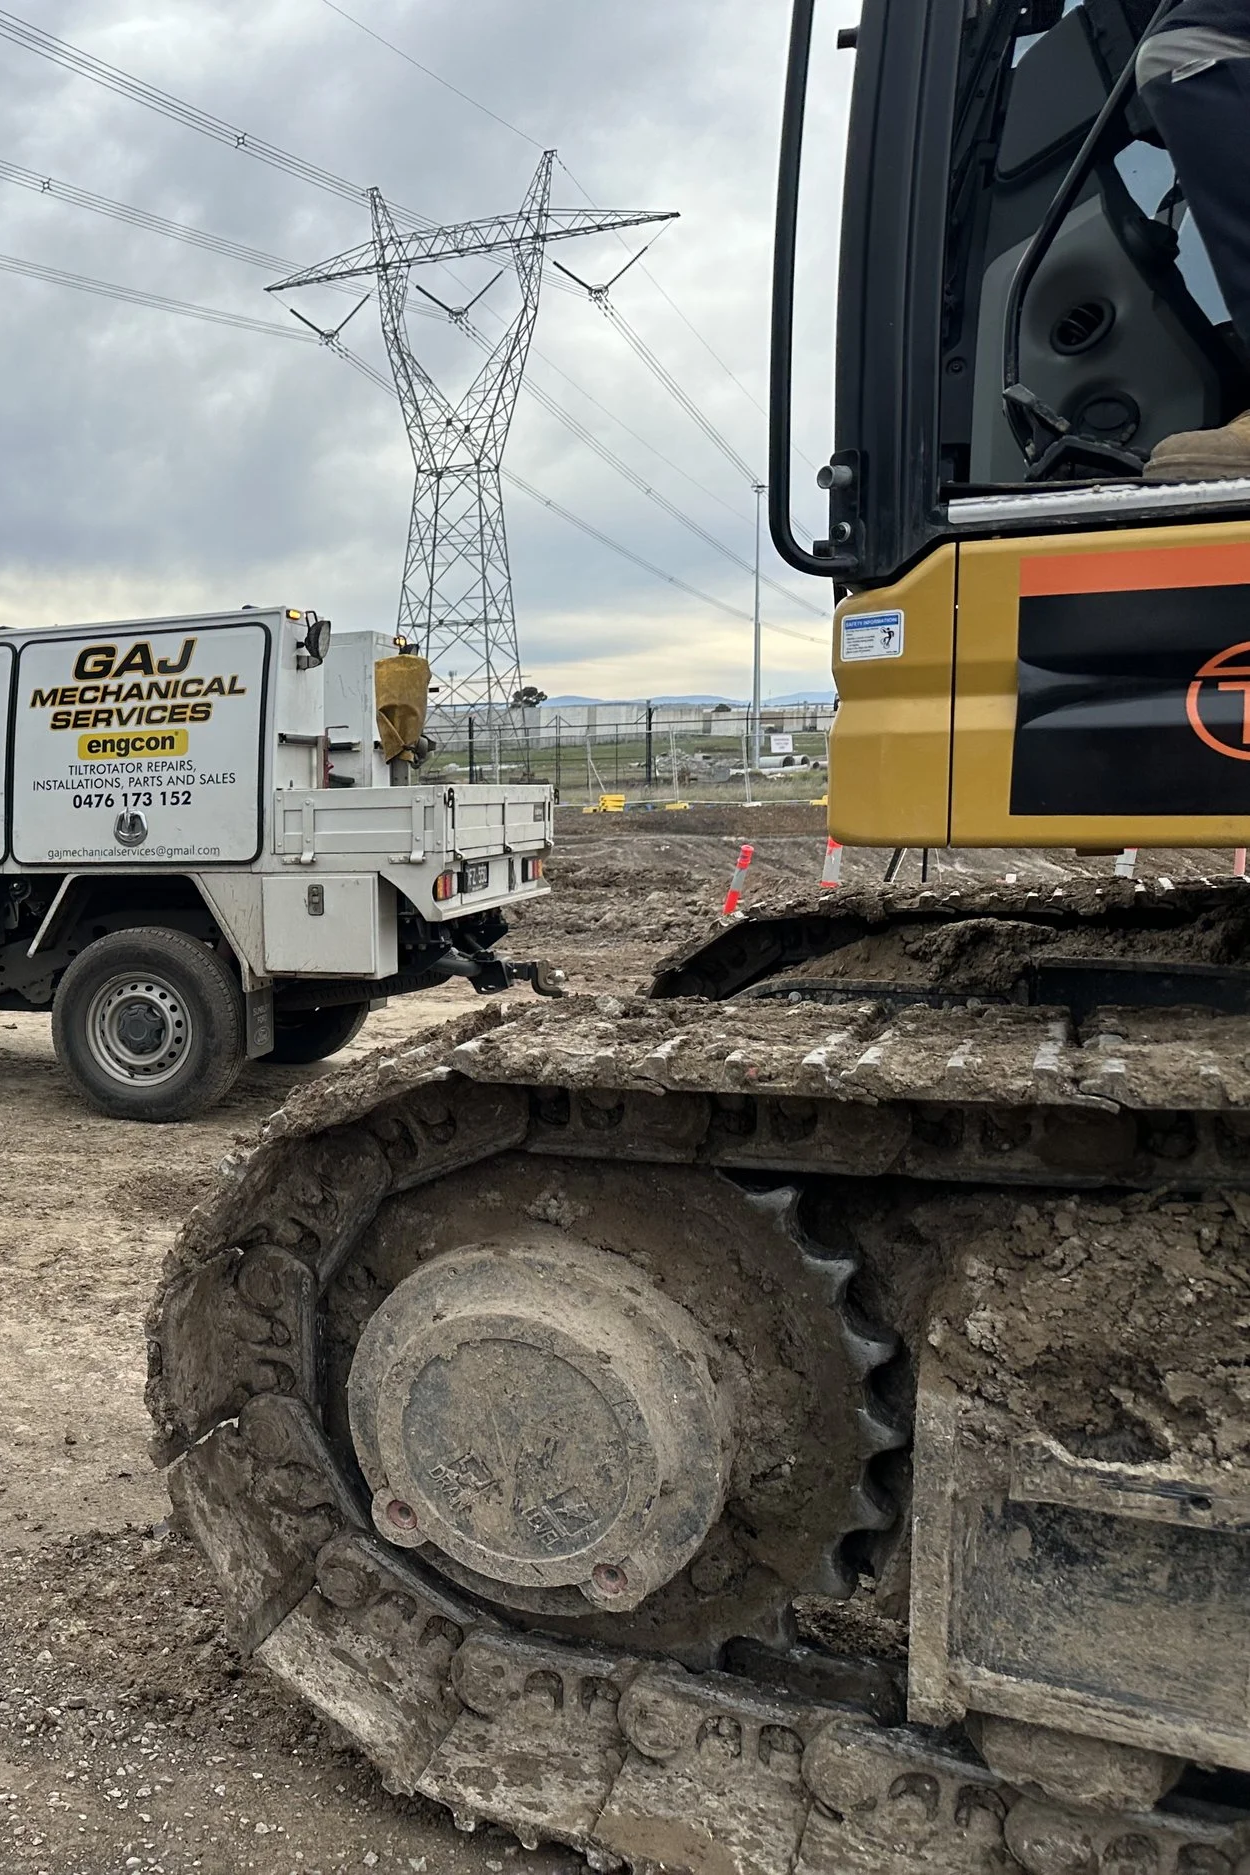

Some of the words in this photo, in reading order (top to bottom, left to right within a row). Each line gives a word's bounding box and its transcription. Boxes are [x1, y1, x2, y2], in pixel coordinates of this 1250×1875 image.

[73, 637, 198, 681] GAJ
[29, 674, 247, 709] MECHANICAL
[49, 701, 213, 731] SERVICES
[87, 735, 175, 757] engcon
[68, 762, 143, 776] TILTROTATOR
[147, 760, 197, 773] REPAIRS,
[33, 778, 124, 792] INSTALLATIONS,
[128, 776, 163, 788] PARTS
[166, 775, 195, 787] AND
[199, 773, 236, 785] SALES
[73, 794, 115, 809] 0476
[121, 792, 152, 807] 173
[160, 791, 192, 806] 152
